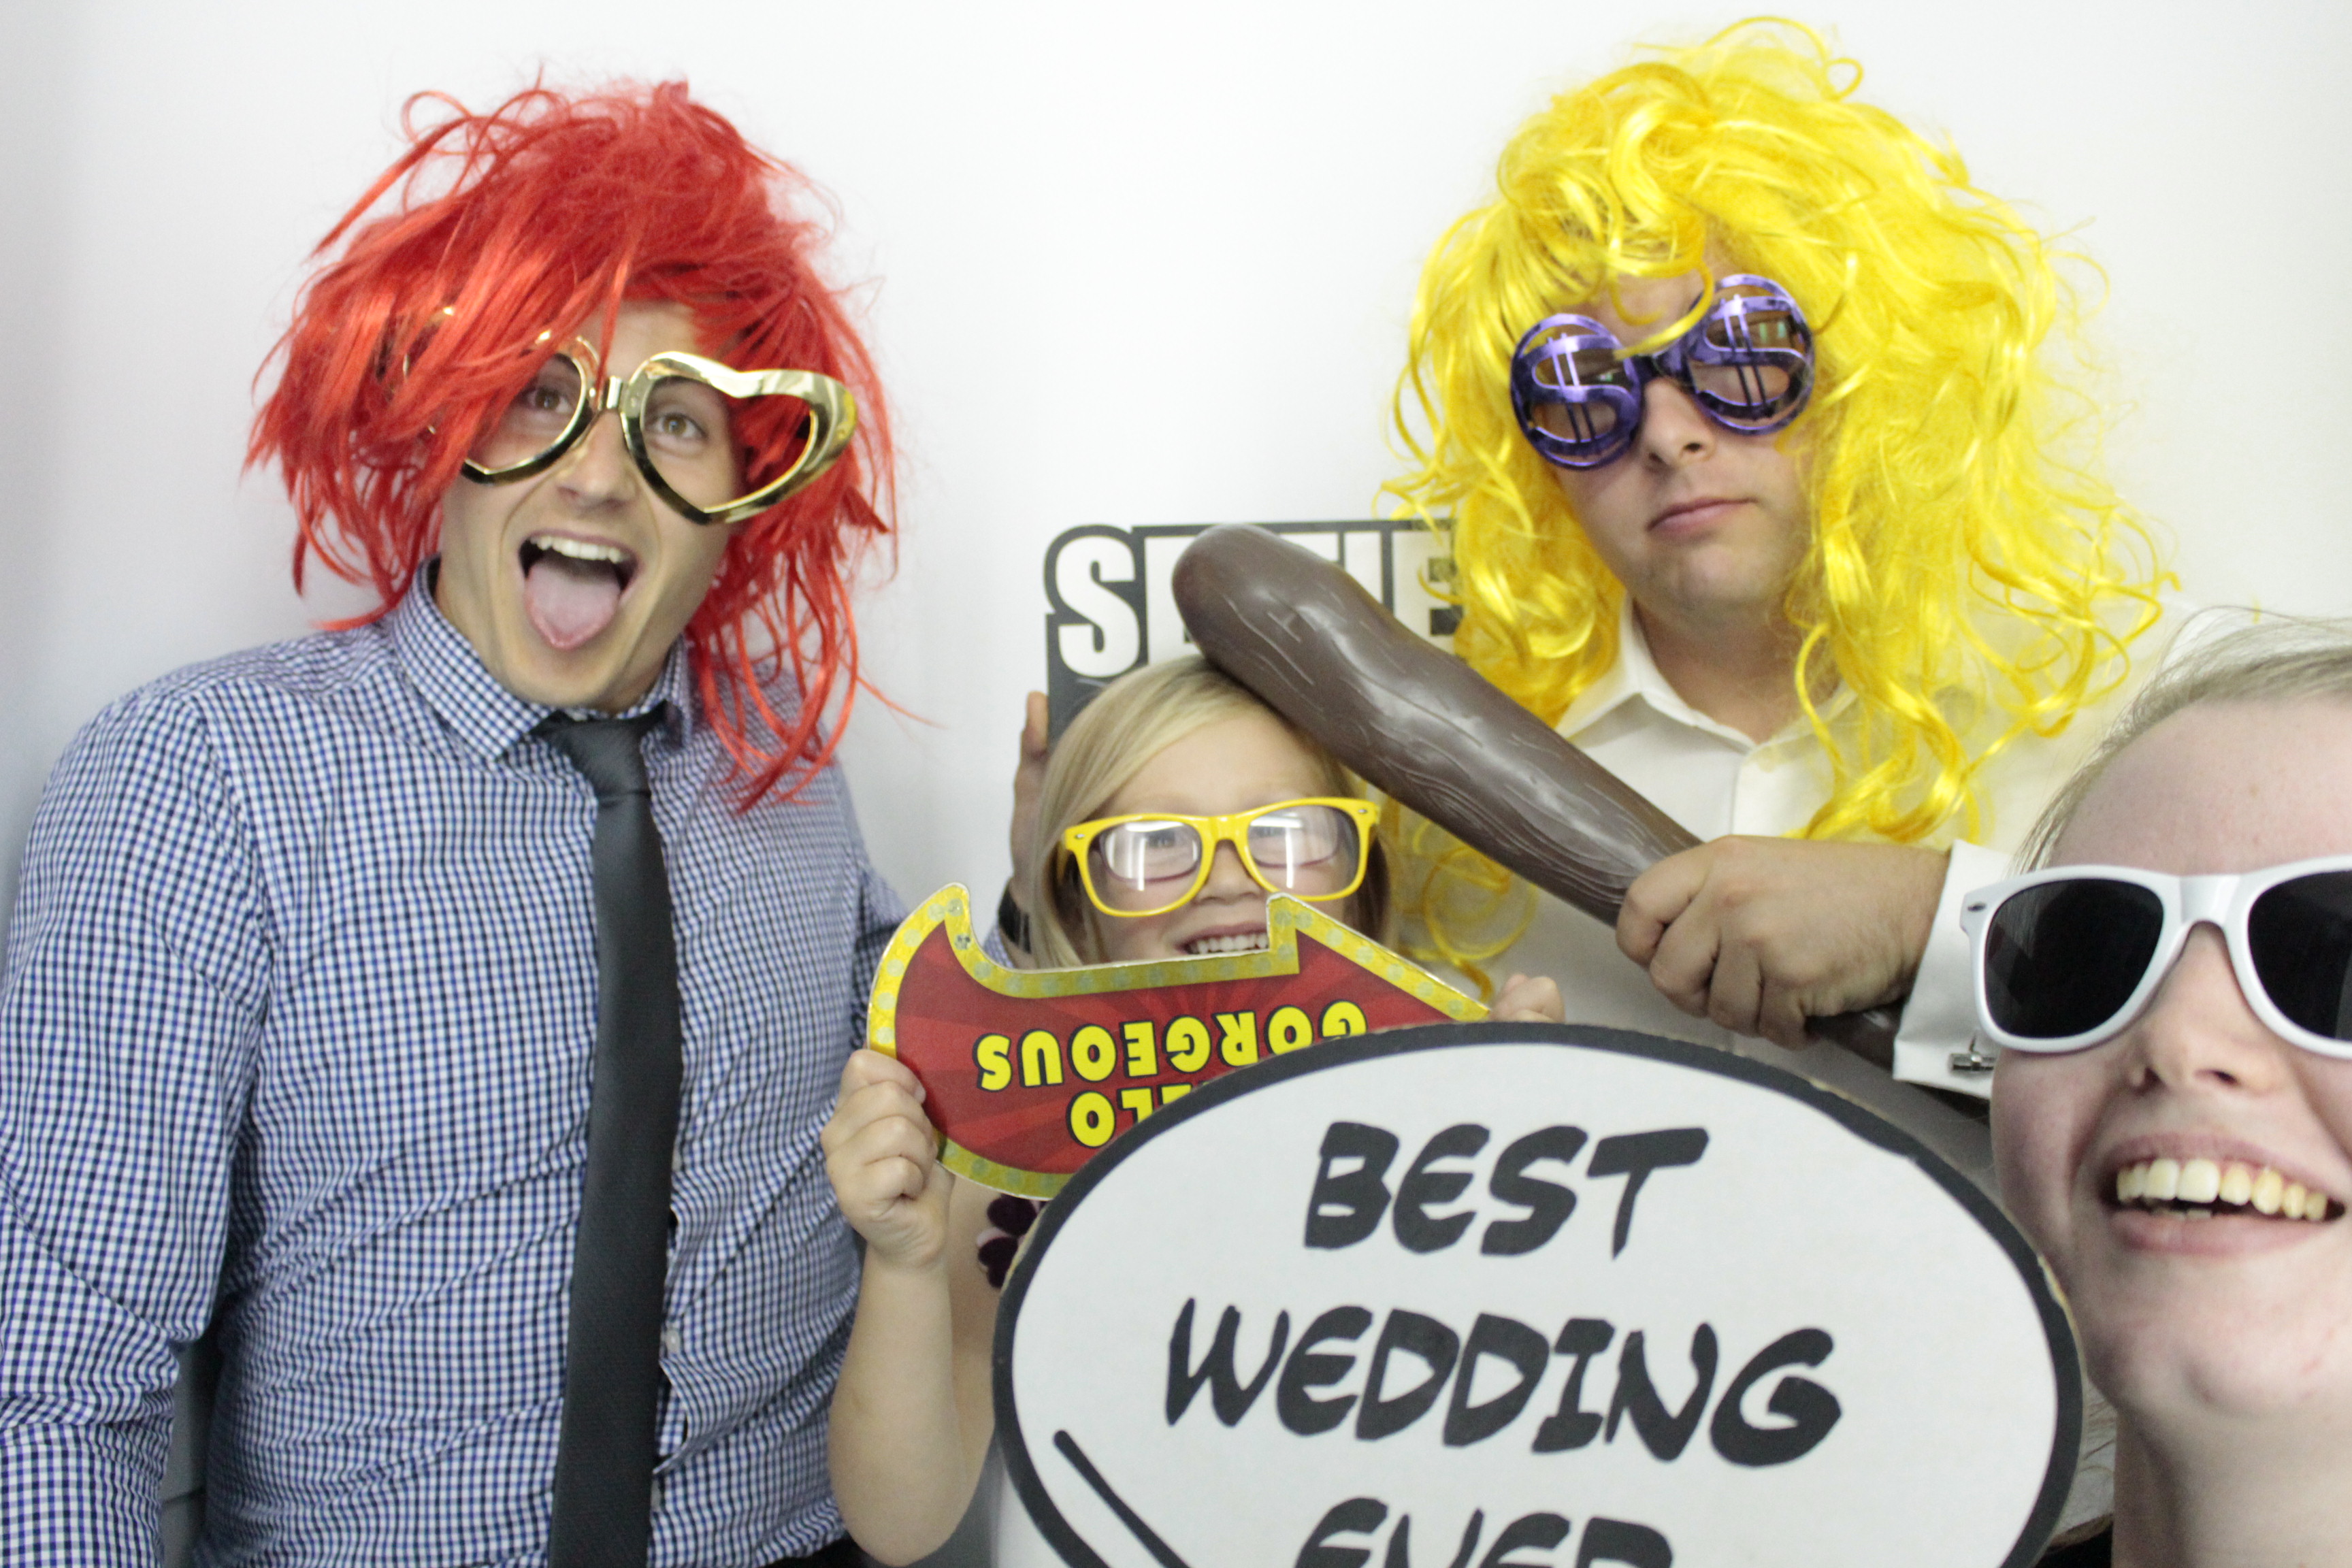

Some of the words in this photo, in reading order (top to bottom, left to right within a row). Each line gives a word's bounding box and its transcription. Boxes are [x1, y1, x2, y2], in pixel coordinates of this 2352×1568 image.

[974, 1000, 1367, 1091] GORGEOUS
[1305, 1122, 1709, 1257] BEST
[1165, 1298, 1842, 1467] WEDDING
